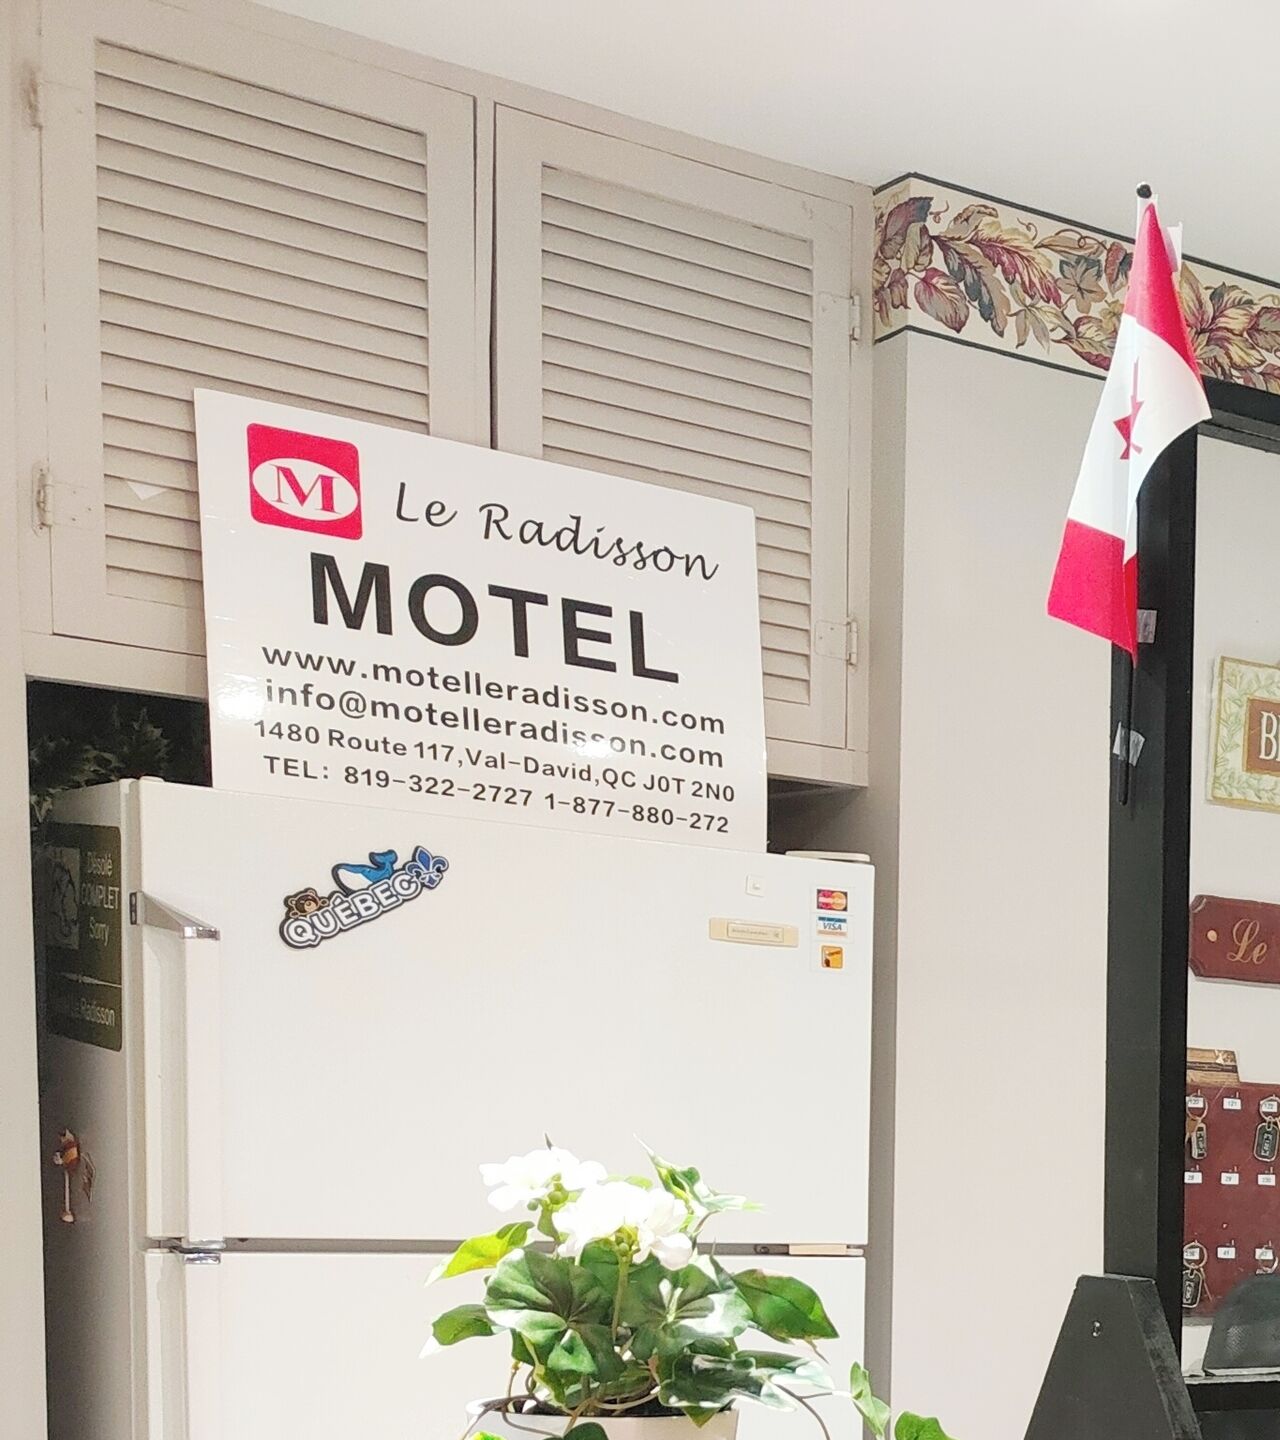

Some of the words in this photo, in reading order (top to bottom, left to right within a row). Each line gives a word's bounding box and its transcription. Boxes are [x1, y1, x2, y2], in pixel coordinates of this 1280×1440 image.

[271, 463, 341, 512] M
[395, 481, 458, 527] Le
[479, 502, 720, 580] Radisson
[309, 552, 679, 684] MOTEL
[261, 645, 726, 735] www.motelleradisson.com
[266, 679, 724, 768] info@motelleradisson.com
[254, 720, 321, 746] 1480
[328, 730, 408, 758] Route
[263, 755, 329, 781] TEL:
[344, 766, 533, 807] 819-322-2727
[543, 793, 730, 833] 1-877-880-272
[286, 873, 419, 944] QUÉBEC
[822, 922, 843, 931] VISA
[1226, 917, 1268, 965] Le
